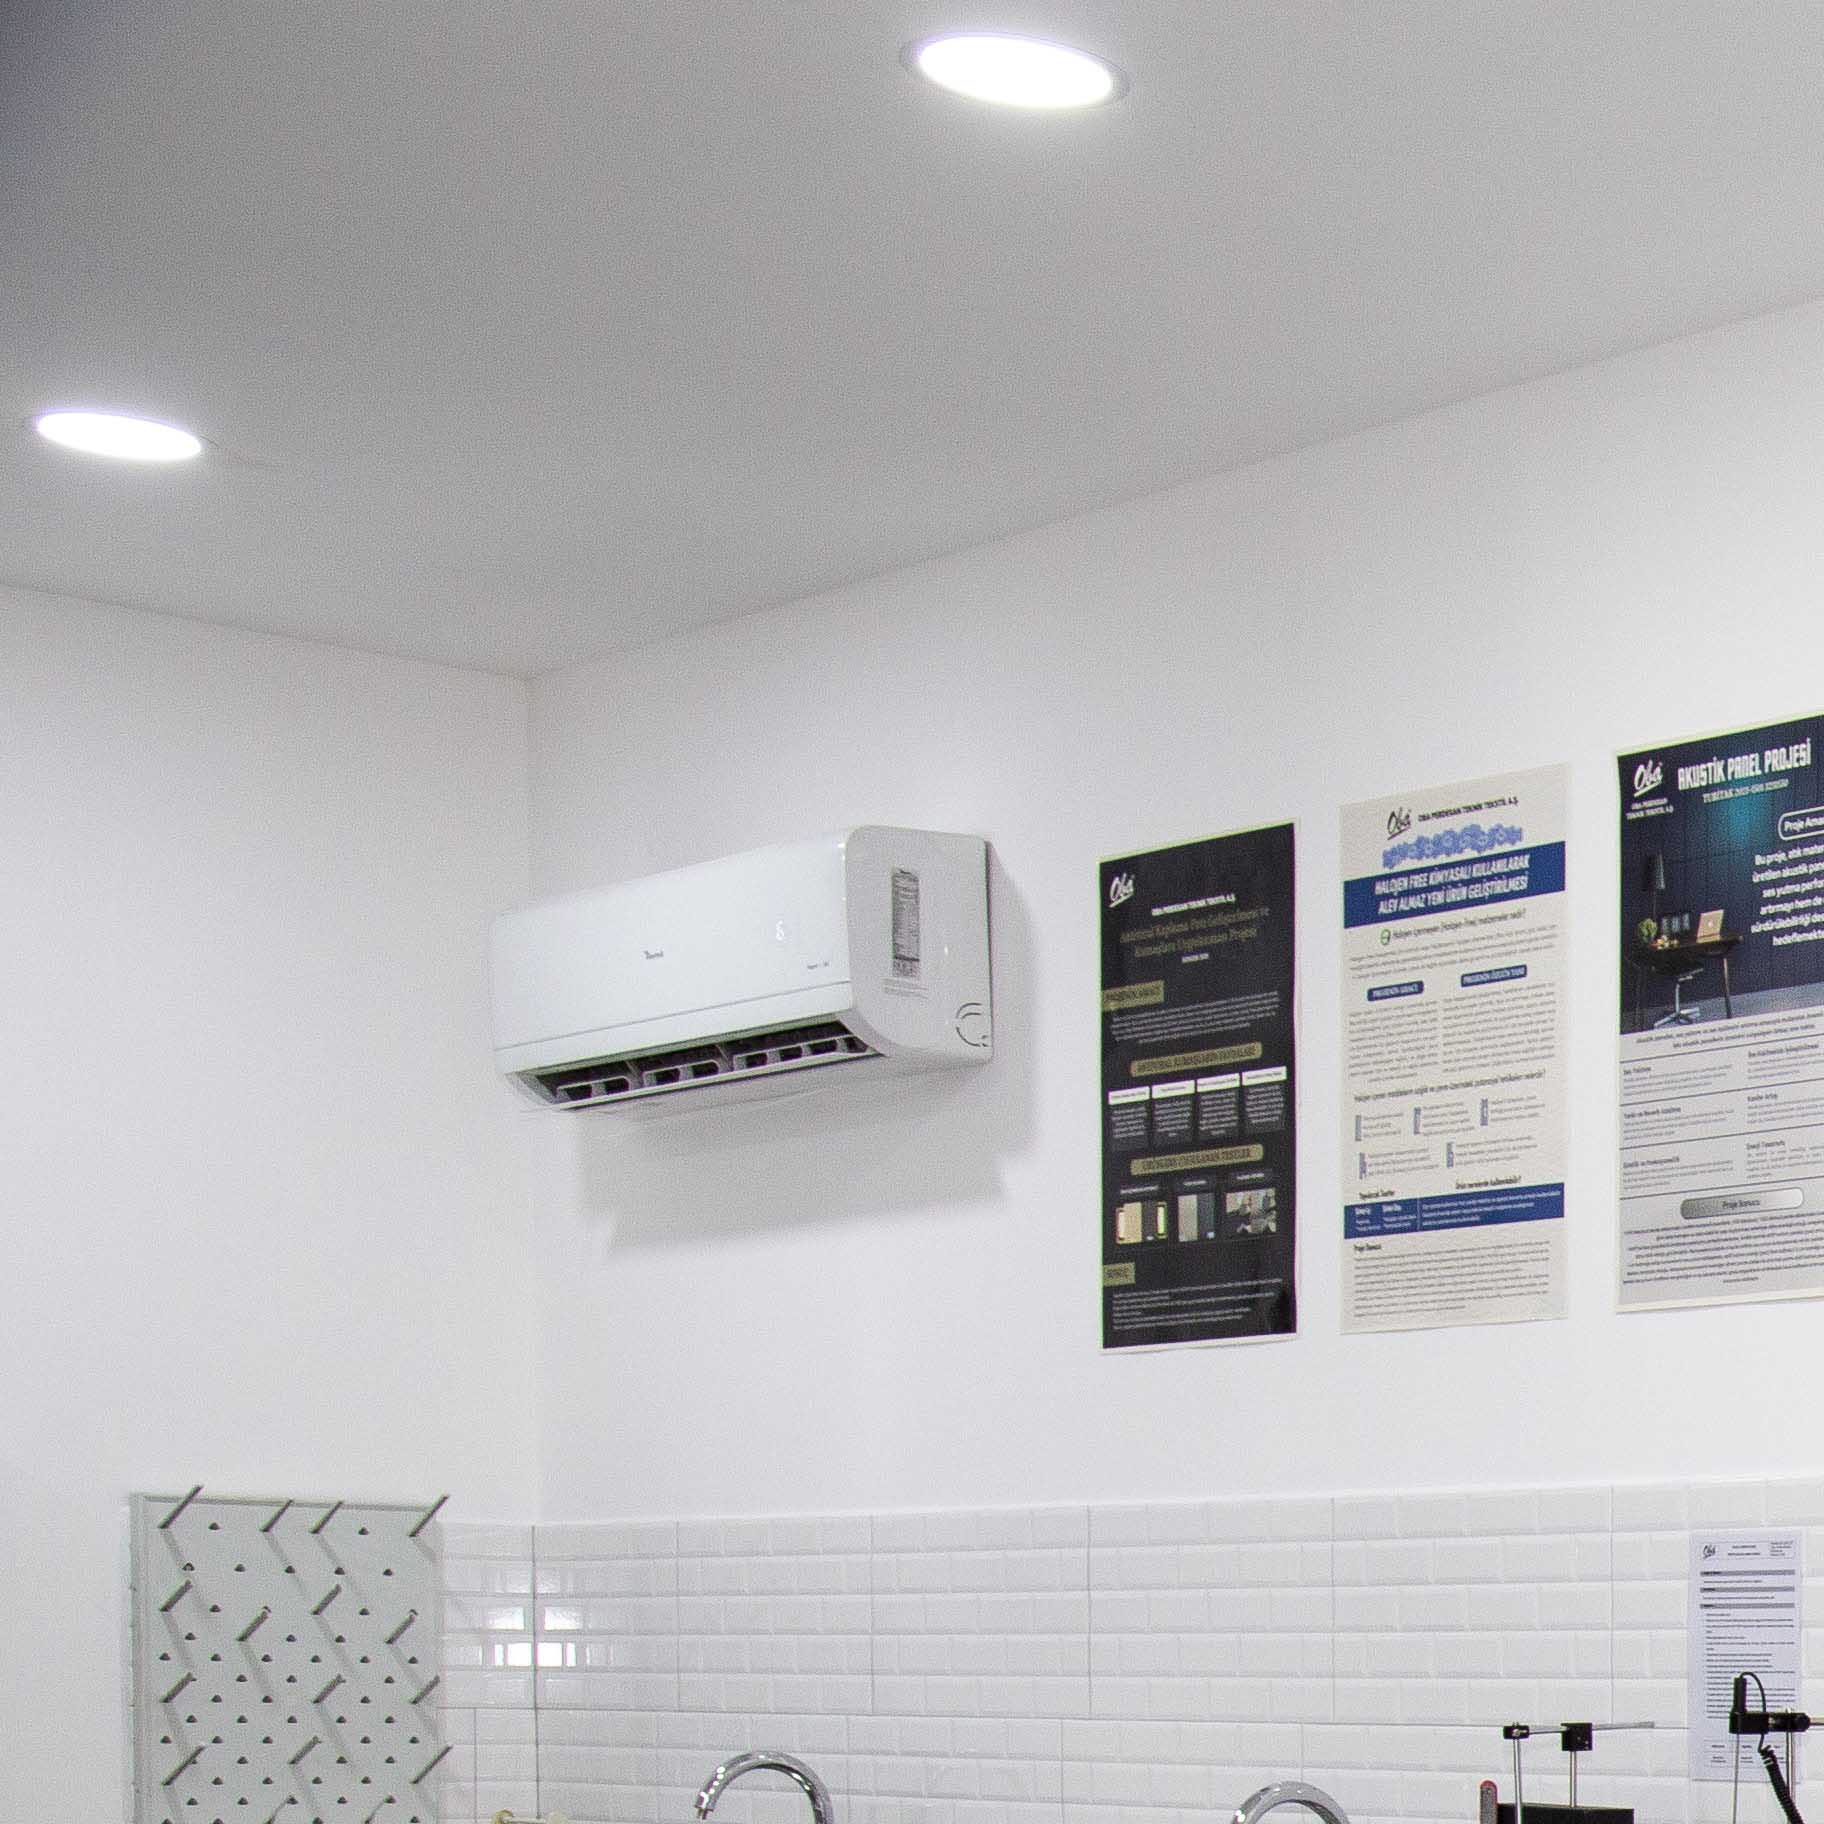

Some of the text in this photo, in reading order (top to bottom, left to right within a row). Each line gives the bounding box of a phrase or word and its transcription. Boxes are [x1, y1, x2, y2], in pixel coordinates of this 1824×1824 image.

[1677, 736, 1811, 791] AKUSTİK PANEL PROJESİ
